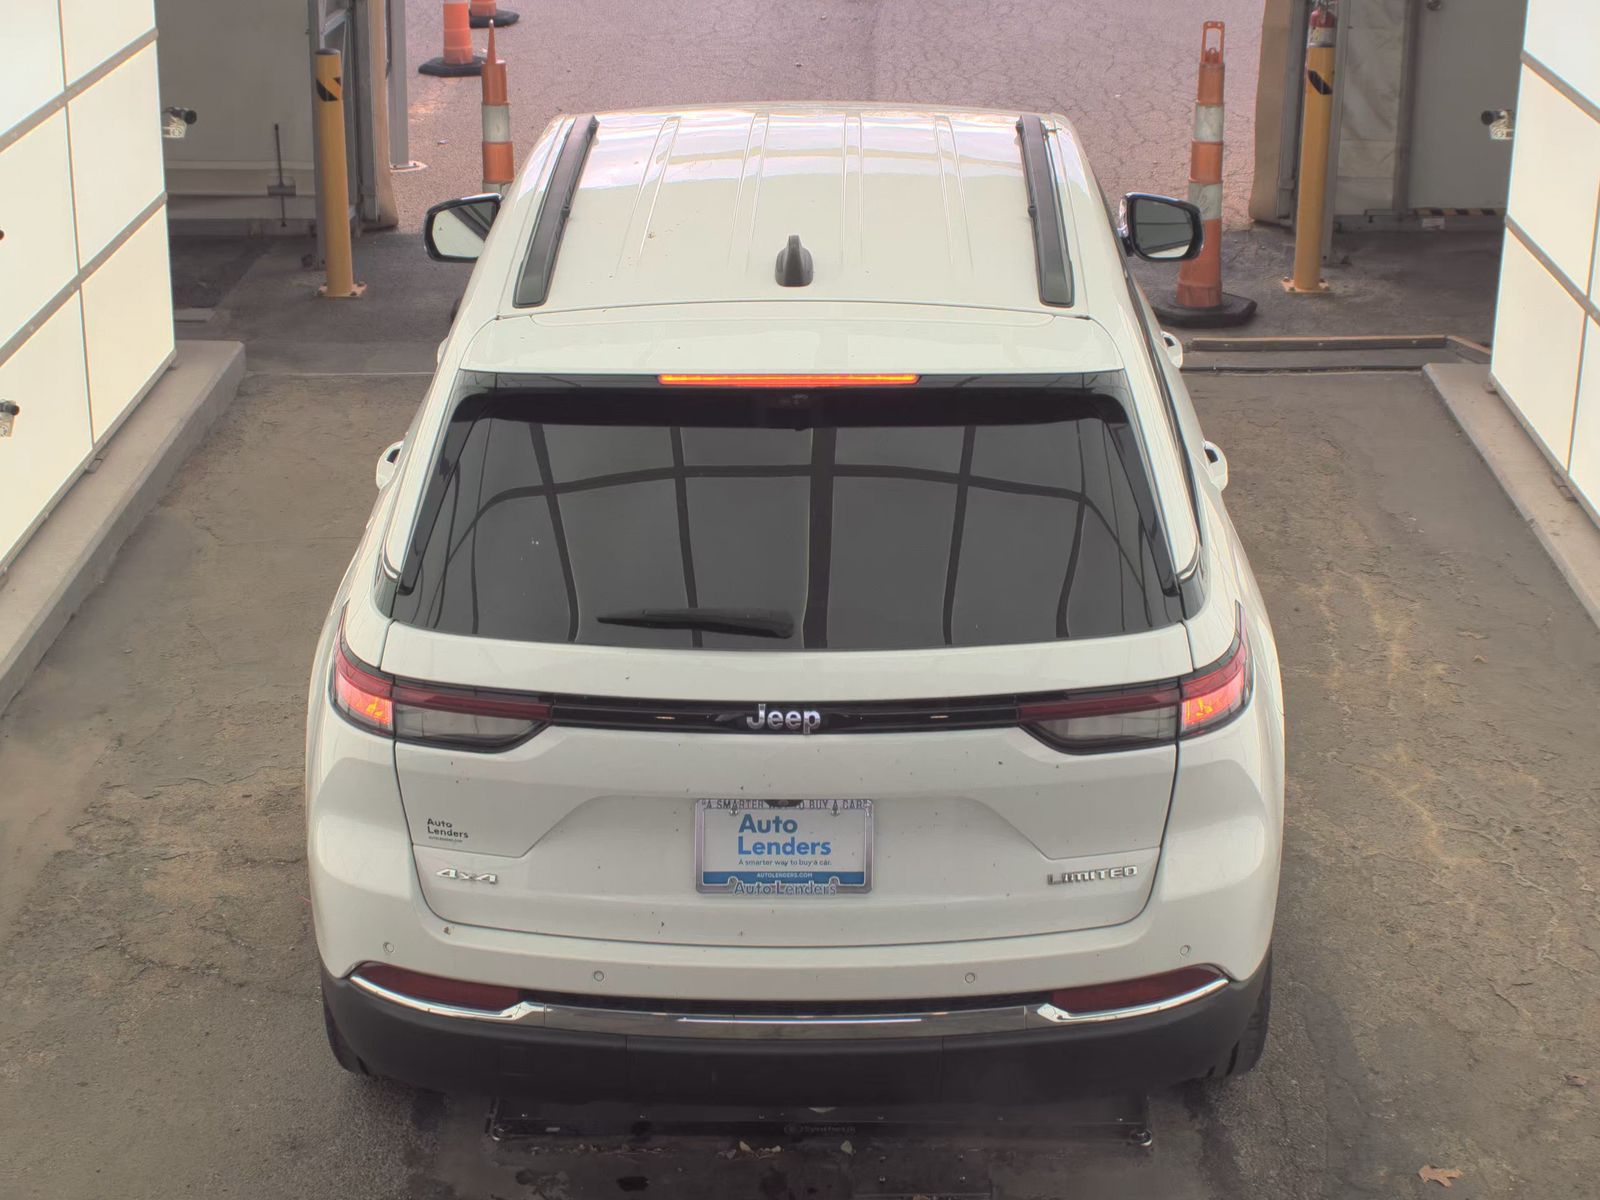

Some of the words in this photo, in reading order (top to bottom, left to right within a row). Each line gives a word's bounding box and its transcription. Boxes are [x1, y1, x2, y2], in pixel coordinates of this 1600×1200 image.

[746, 703, 821, 735] Jeep
[717, 800, 764, 809] SMARTER
[810, 800, 828, 809] BUY
[427, 818, 453, 828] Auto
[738, 813, 798, 833] Auto
[427, 826, 469, 838] Lenders
[738, 836, 832, 855] Lenders
[799, 859, 811, 867] buy
[1047, 865, 1138, 885] LIMITED
[735, 881, 772, 895] Auto
[775, 880, 837, 895] Lenders
